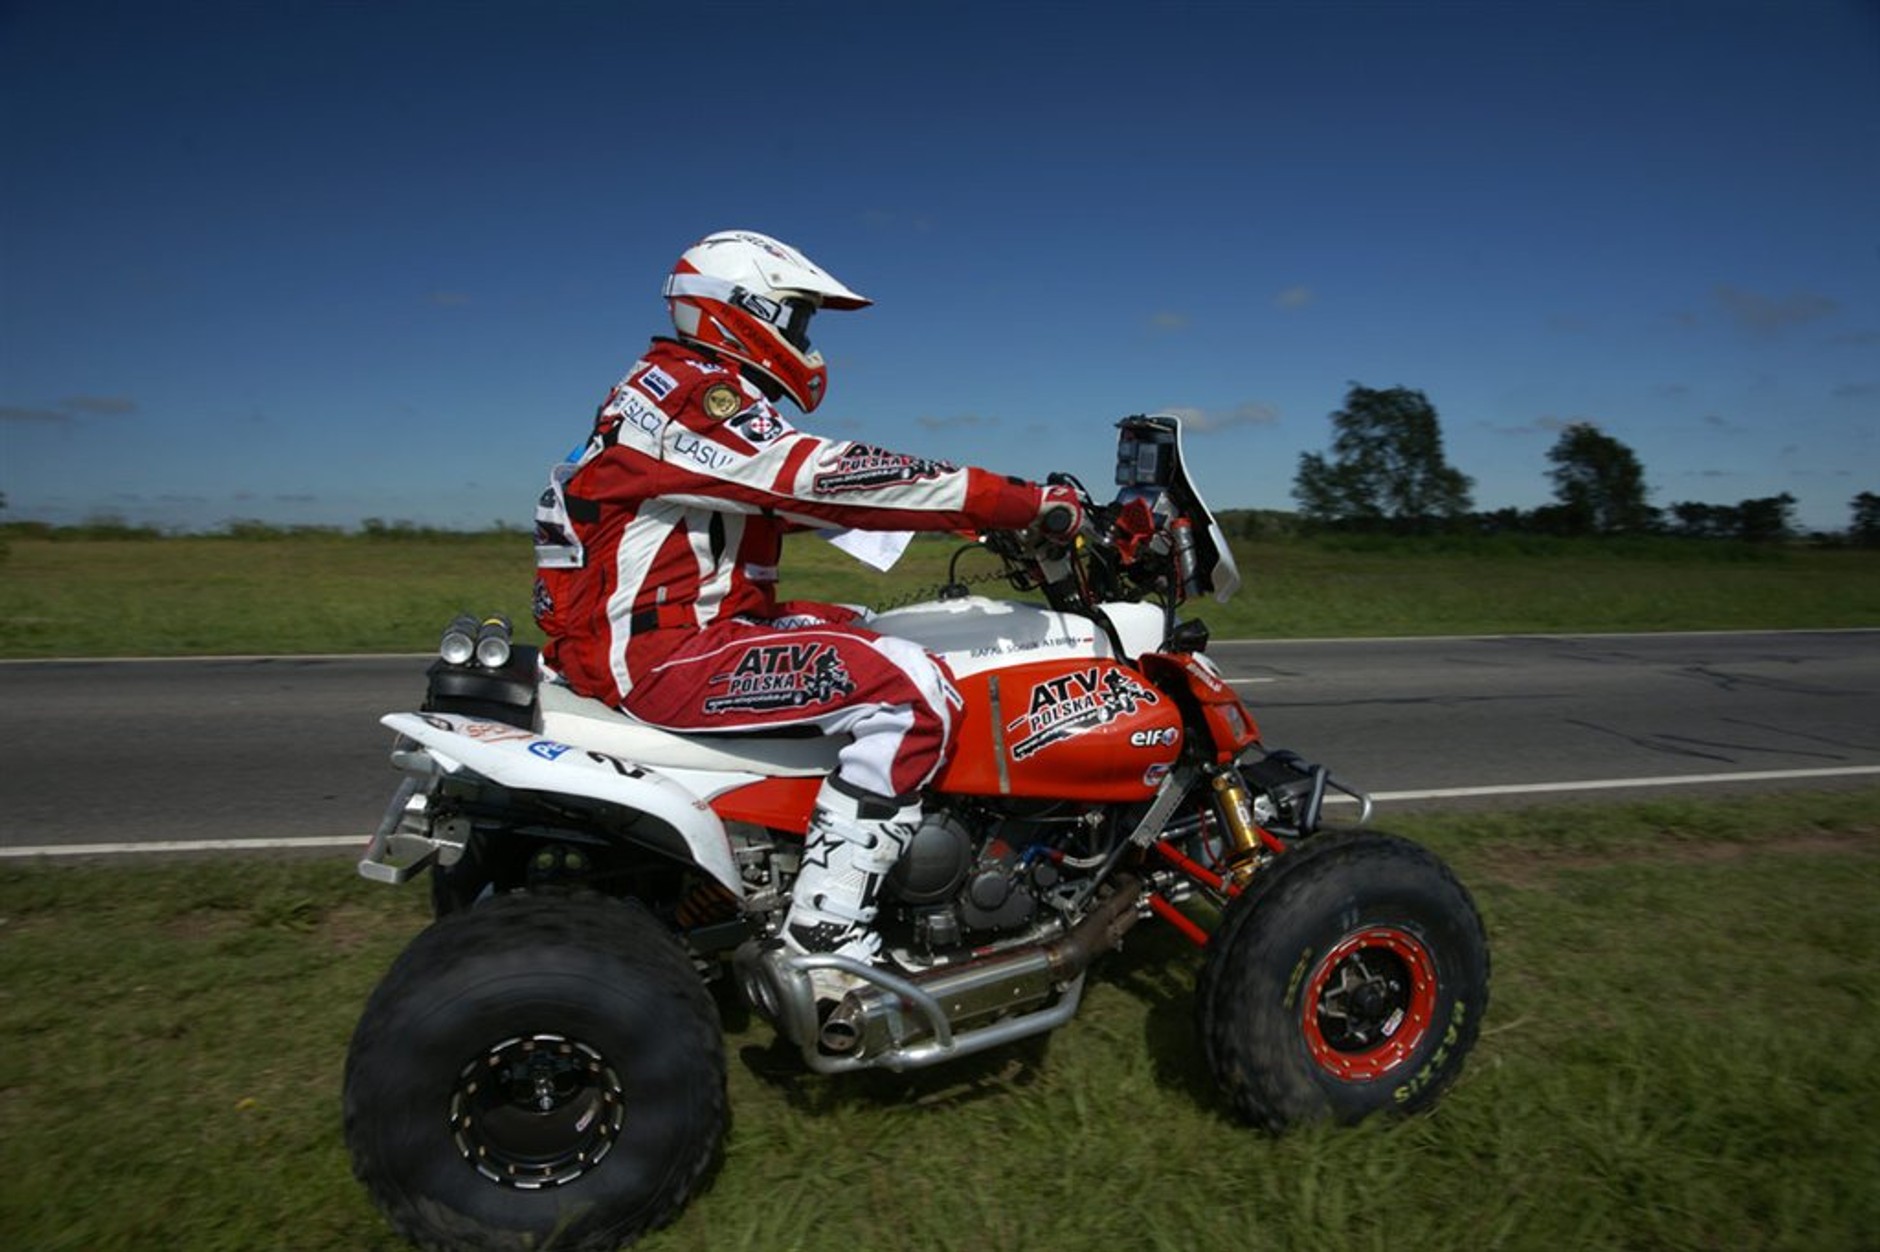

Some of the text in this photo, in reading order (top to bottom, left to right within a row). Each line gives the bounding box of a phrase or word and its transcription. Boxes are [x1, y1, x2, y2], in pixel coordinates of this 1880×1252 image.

[841, 457, 900, 471] POLSKA
[735, 643, 819, 677] ATV
[730, 674, 795, 693] POLSKA
[1030, 668, 1098, 714] ATV
[1031, 695, 1095, 731] POLSKA
